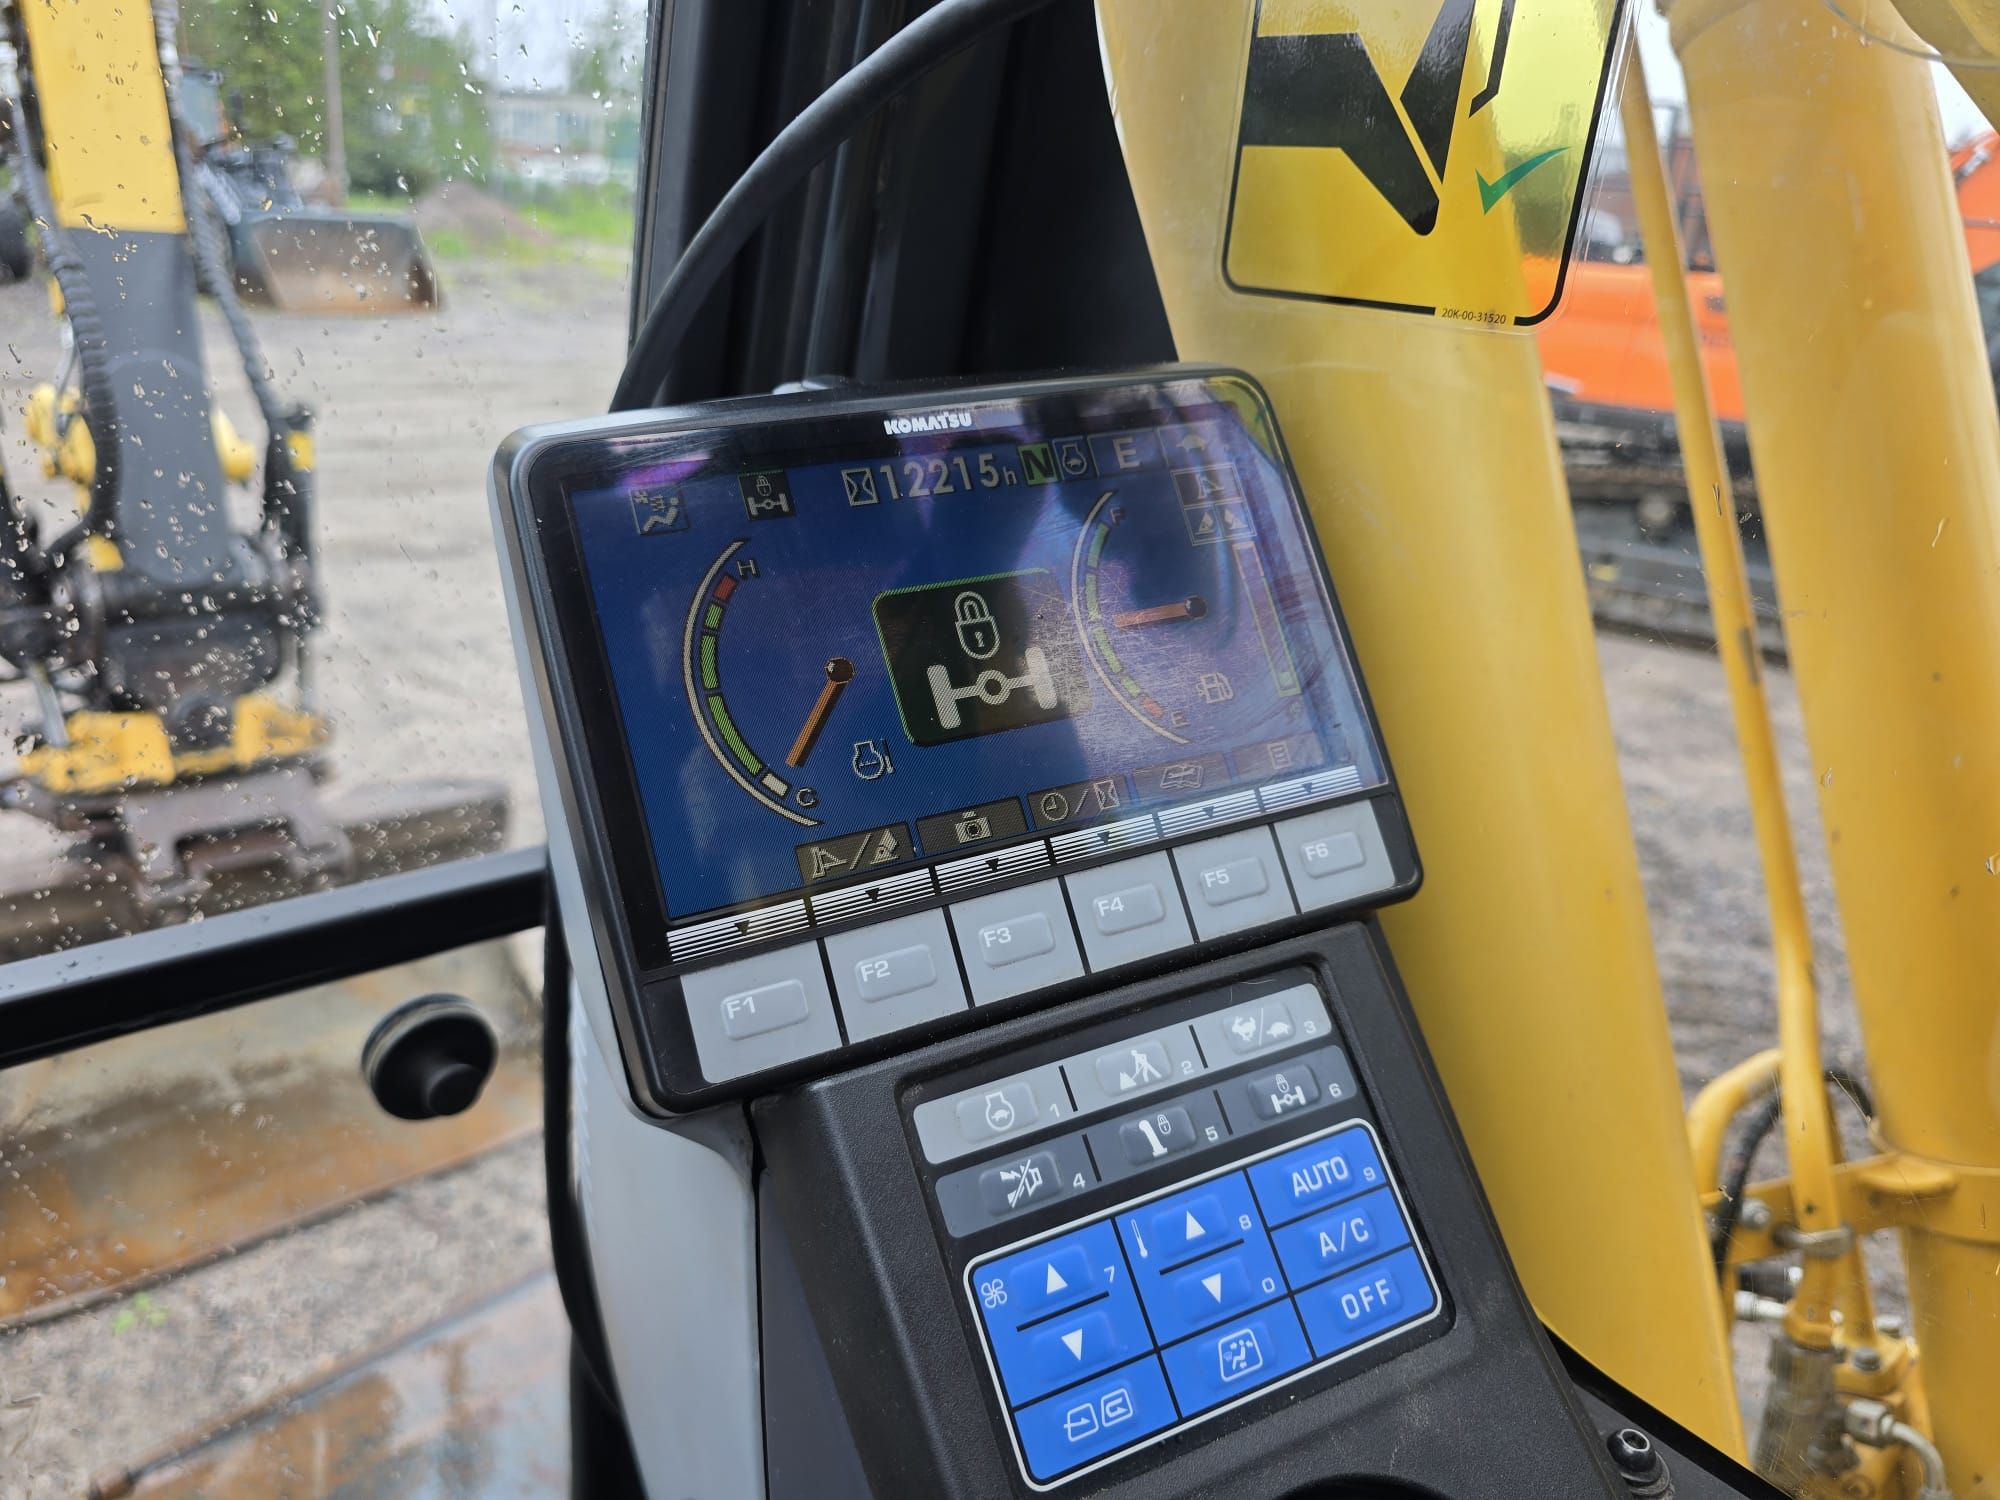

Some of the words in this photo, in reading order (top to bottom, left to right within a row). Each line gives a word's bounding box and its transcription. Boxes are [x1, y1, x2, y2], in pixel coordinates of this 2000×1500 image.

[1441, 308, 1507, 324] 20K-00-31520
[884, 411, 973, 436] KOMATSU
[1112, 436, 1141, 469] E
[1110, 506, 1124, 524] F
[737, 559, 761, 577] H
[1171, 711, 1190, 728] E
[796, 787, 817, 807] C
[1304, 842, 1329, 862] F6
[1204, 869, 1230, 888] F5
[1097, 896, 1125, 917] F4
[983, 927, 1012, 948] F3
[860, 960, 891, 983] F2
[726, 996, 756, 1020] F1
[1304, 1020, 1318, 1034] 3
[1181, 1060, 1194, 1075] 2
[1328, 1083, 1342, 1098] 6
[1049, 1103, 1061, 1119] 1
[1205, 1126, 1218, 1141] 5
[1072, 1172, 1086, 1189] 4
[1291, 1155, 1348, 1197] AUTO
[1363, 1167, 1376, 1181] 9
[1239, 1214, 1252, 1230] 8
[1318, 1217, 1369, 1257] A/C
[1104, 1266, 1116, 1283] 7
[1340, 1279, 1391, 1320] OFF
